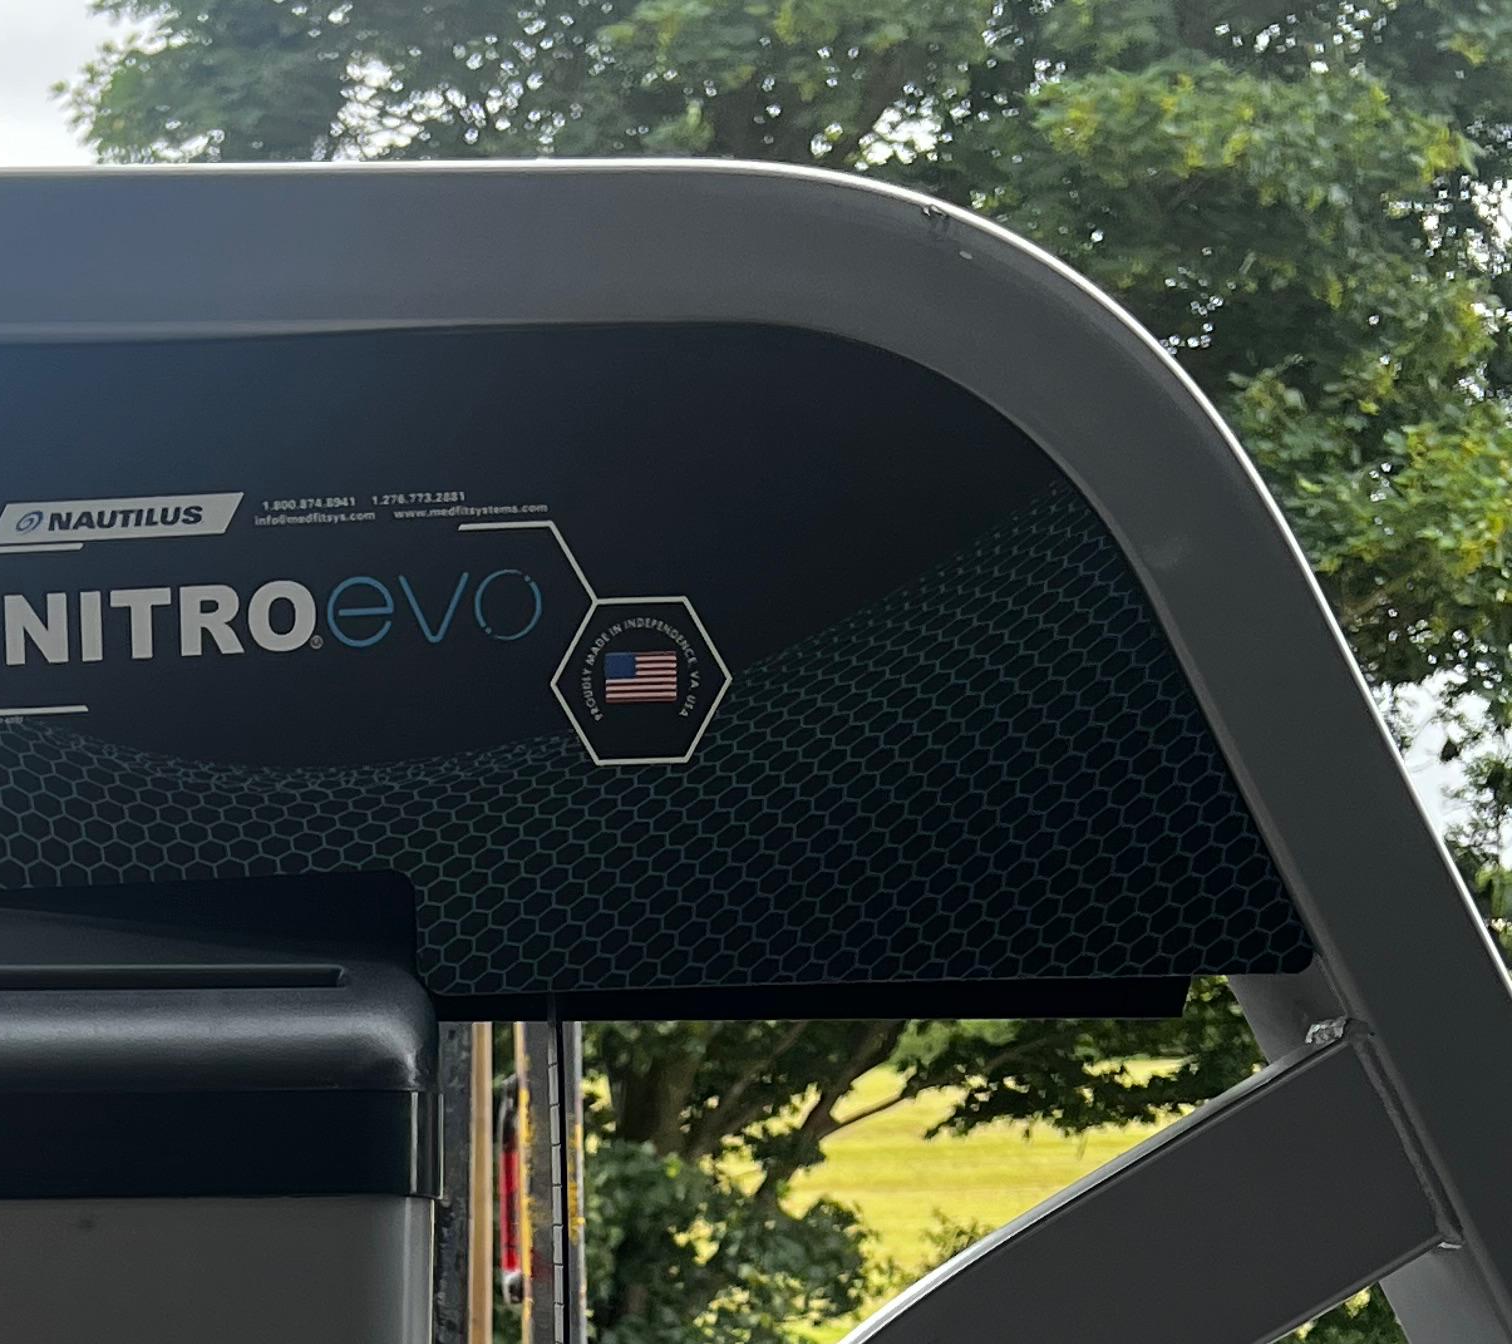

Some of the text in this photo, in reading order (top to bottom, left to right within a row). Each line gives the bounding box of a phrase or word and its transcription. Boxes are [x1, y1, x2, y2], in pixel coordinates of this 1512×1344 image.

[48, 505, 203, 531] NAUTILUS
[393, 504, 549, 519] www.medfitsystems.com
[609, 623, 622, 636] IN
[586, 632, 610, 666] MADE
[582, 667, 603, 721] PROUDLY
[679, 695, 696, 717] USA
